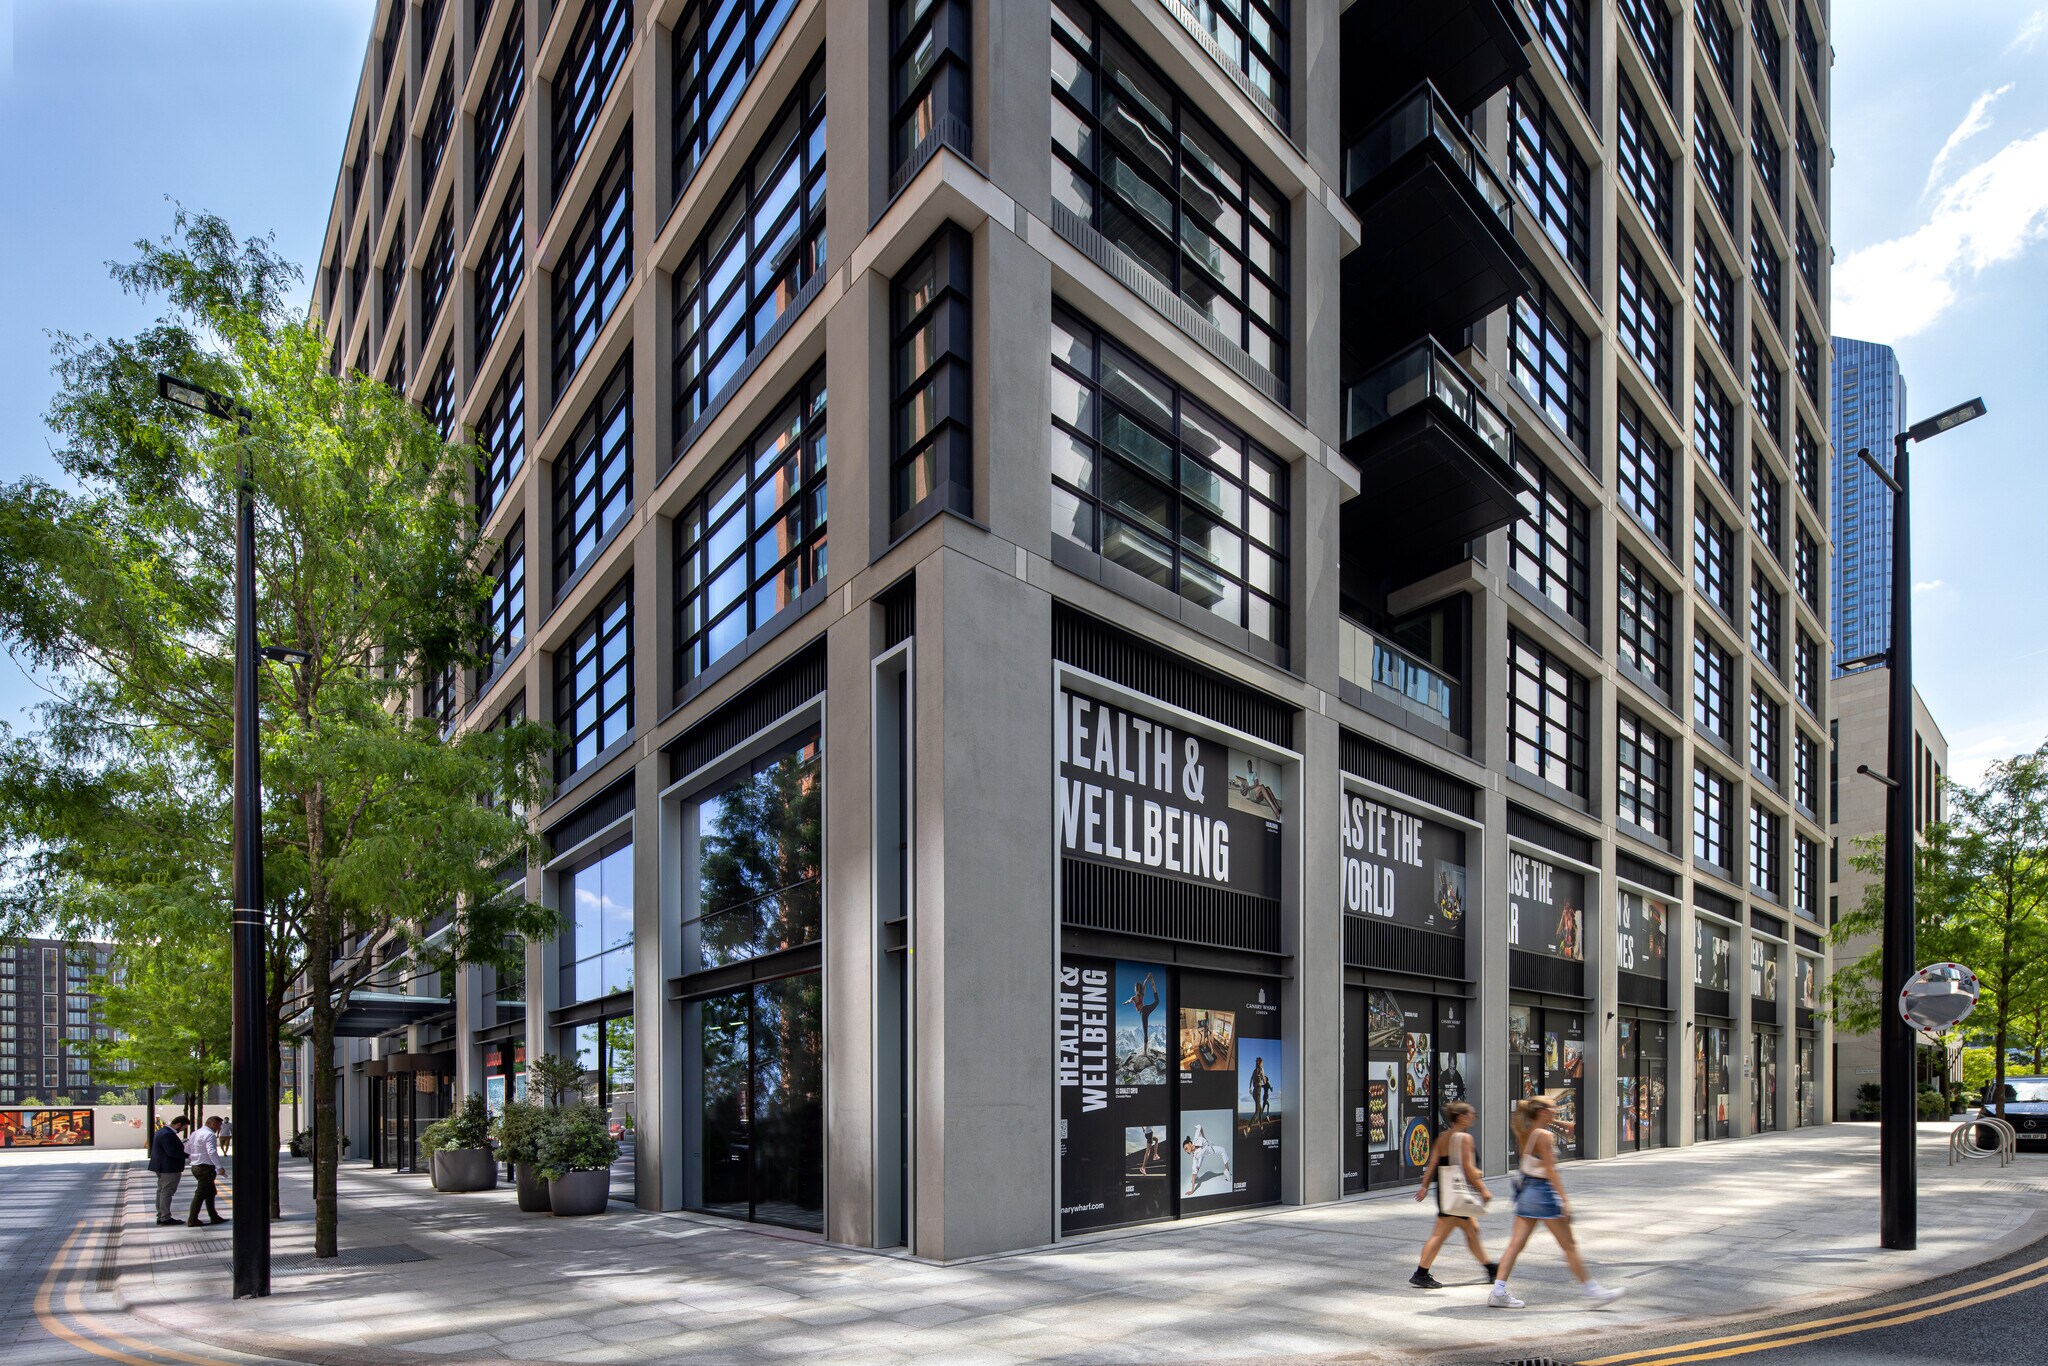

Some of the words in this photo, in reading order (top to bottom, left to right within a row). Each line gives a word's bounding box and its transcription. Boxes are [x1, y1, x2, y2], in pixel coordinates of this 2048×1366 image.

[1182, 737, 1205, 804] &
[1061, 776, 1229, 882] WELLBEING
[1391, 810, 1423, 868] THE
[1531, 860, 1553, 906] THE
[1623, 894, 1631, 930] &
[1061, 993, 1079, 1086] HEALTH
[1082, 970, 1107, 1112] WELLBEING
